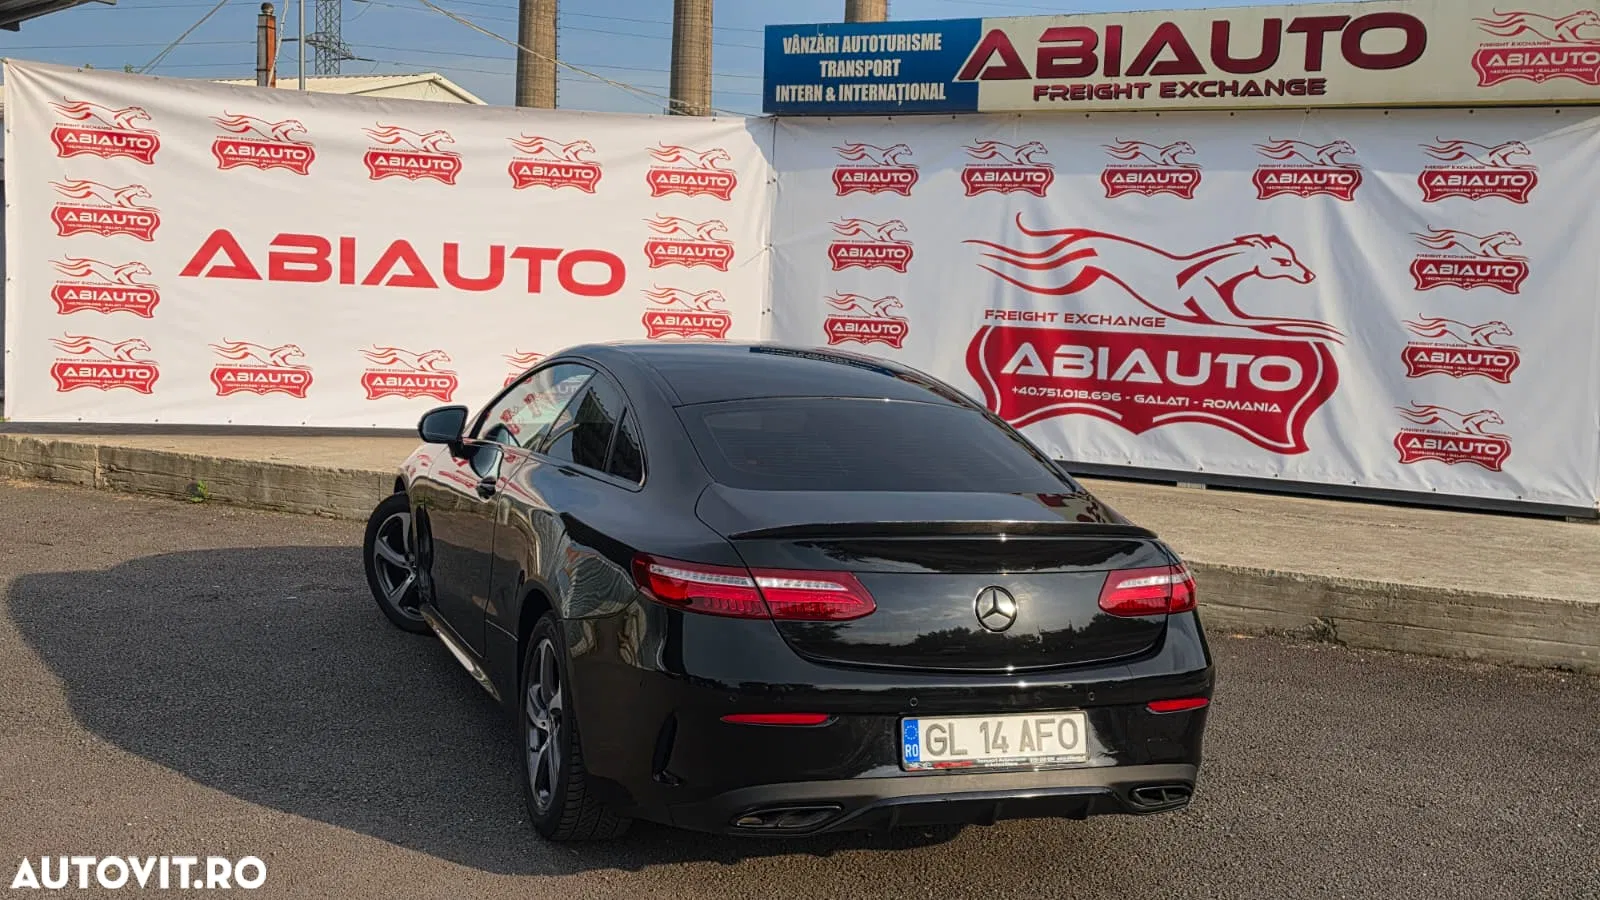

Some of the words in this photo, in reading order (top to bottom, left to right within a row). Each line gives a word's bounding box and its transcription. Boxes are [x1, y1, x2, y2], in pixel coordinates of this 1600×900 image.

[782, 32, 839, 55] VÂNZĂRI
[841, 32, 943, 54] AUTOTURISME
[953, 12, 1428, 82] ABIAUTO
[1486, 51, 1600, 67] ABIAUTO
[819, 58, 901, 78] TRANSPORT
[776, 84, 824, 103] INTERN
[825, 86, 836, 102] &
[1033, 82, 1151, 102] FREIGHT
[1159, 77, 1327, 99] EXCHANGE
[63, 132, 152, 149] ABIAUTO
[223, 144, 307, 160] ABIAUTO
[374, 156, 454, 170] ABIAUTO
[518, 165, 594, 179] ABIAUTO
[841, 171, 912, 183] ABIAUTO
[970, 171, 1047, 183] ABIAUTO
[1111, 172, 1193, 184] ABIAUTO
[1263, 173, 1353, 185] ABIAUTO
[656, 174, 730, 187] ABIAUTO
[1430, 174, 1527, 186] ABIAUTO
[63, 210, 152, 226] ABIAUTO
[653, 245, 728, 258] ABIAUTO
[836, 247, 906, 258] ABIAUTO
[178, 228, 626, 297] ABIAUTO
[1422, 263, 1519, 277] ABIAUTO
[63, 288, 151, 304] ABIAUTO
[652, 315, 725, 328] ABIAUTO
[984, 309, 1060, 323] FREIGHT
[1064, 312, 1167, 328] EXCHANGE
[832, 322, 902, 334] ABIAUTO
[1413, 351, 1510, 366] ABIAUTO
[63, 366, 151, 380] ABIAUTO
[1001, 341, 1303, 392] ABIAUTO
[222, 371, 305, 385] ABIAUTO
[371, 376, 451, 389] ABIAUTO
[1011, 385, 1122, 402] +40.751.018.696
[1134, 394, 1190, 407] GALATI
[1202, 398, 1282, 414] ROMANIA
[1406, 437, 1502, 455] ABIAUTO
[925, 722, 968, 757] GL
[979, 720, 1010, 754] 14
[1019, 717, 1079, 752] AFO
[905, 743, 919, 758] RO
